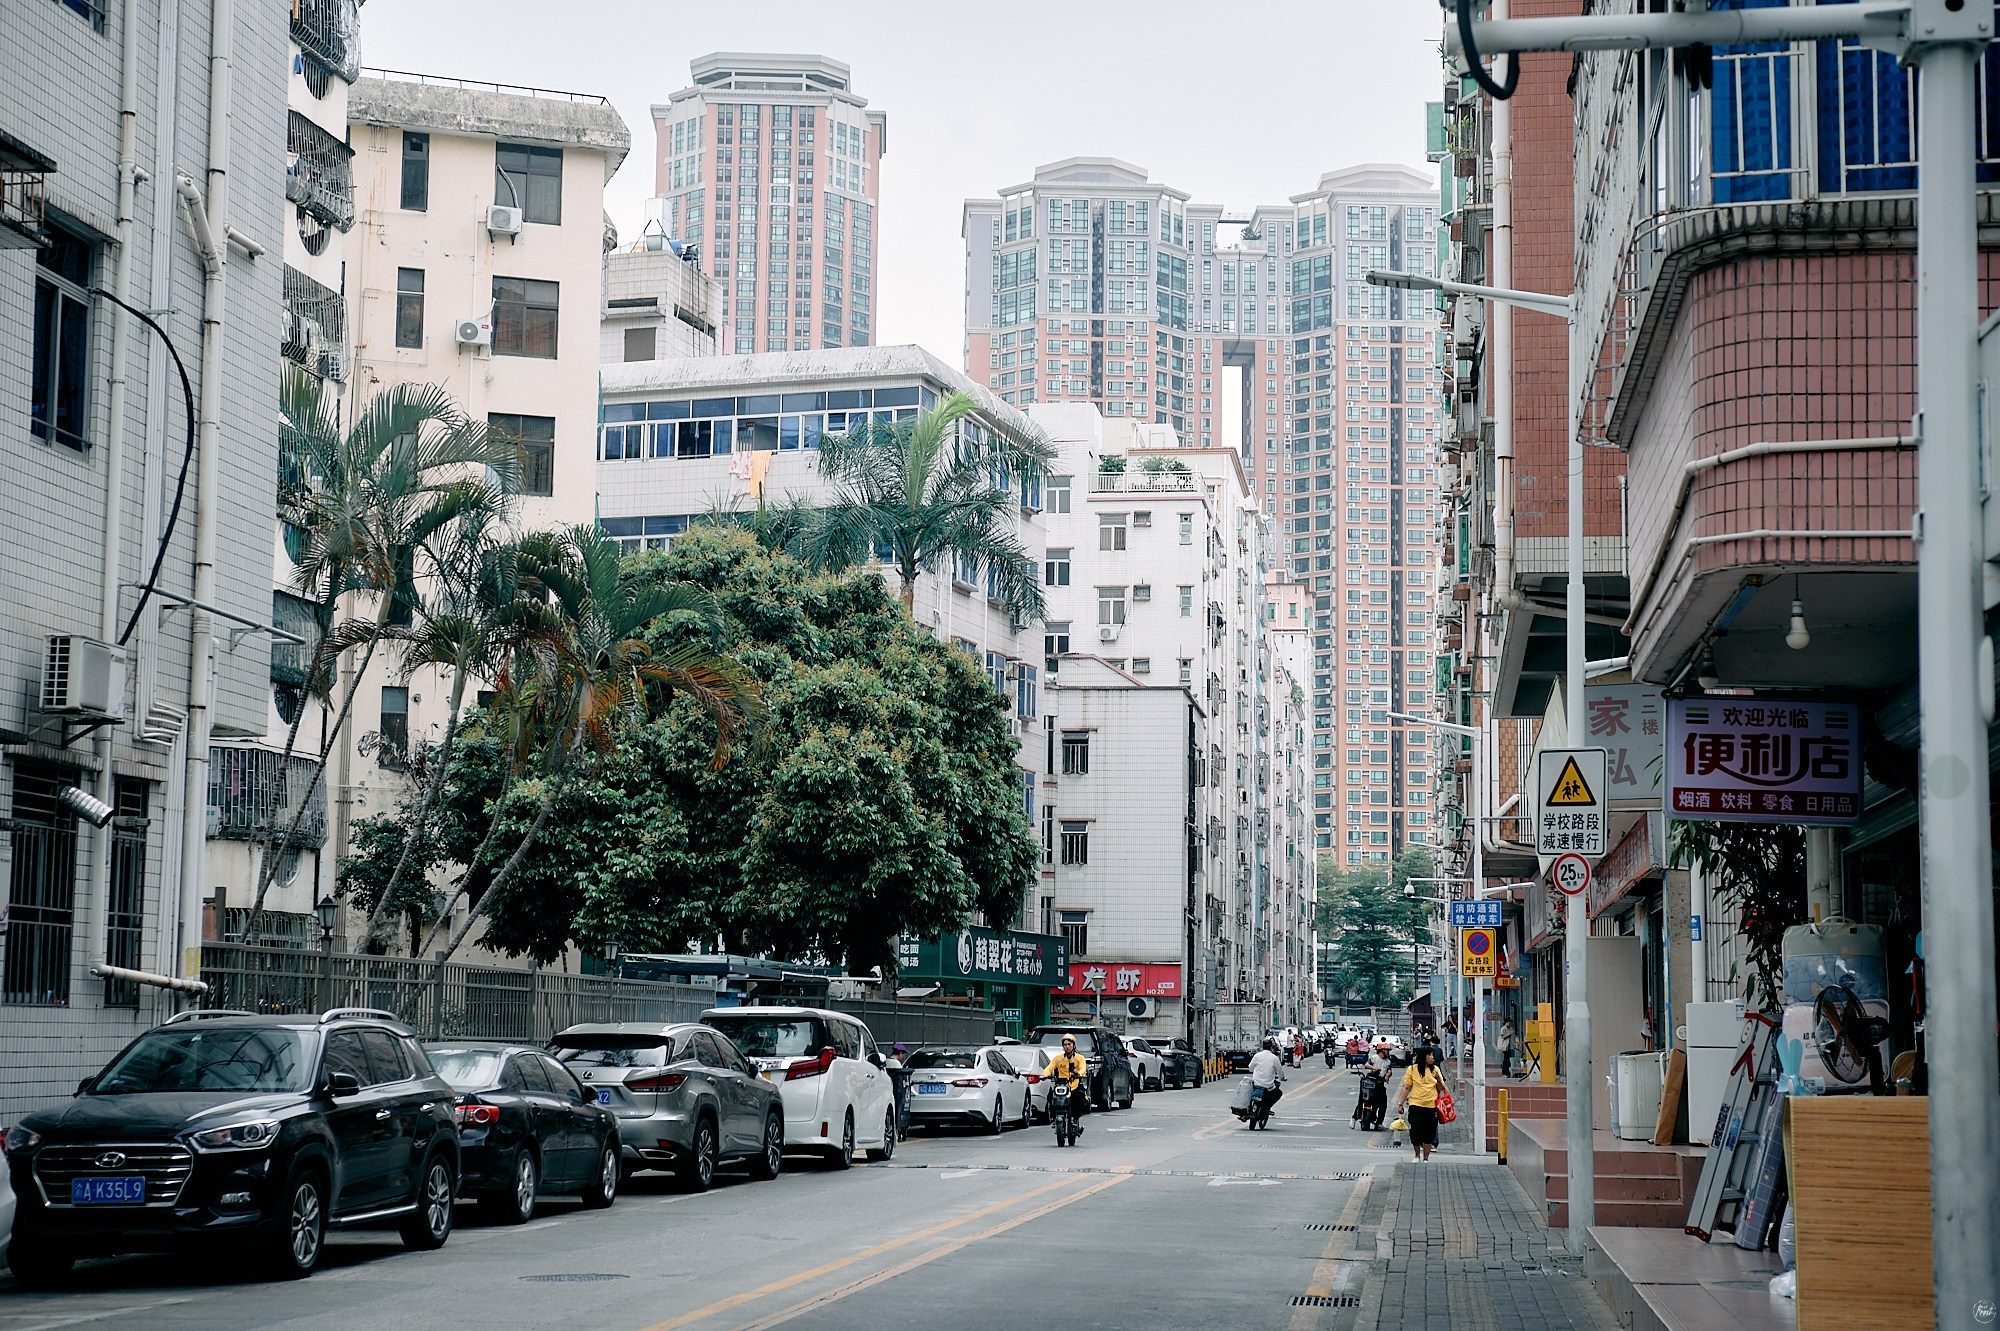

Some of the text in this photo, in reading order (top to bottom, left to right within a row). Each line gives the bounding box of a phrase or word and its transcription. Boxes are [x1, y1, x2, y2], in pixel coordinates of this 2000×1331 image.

[1722, 706, 1809, 729] 欢迎光临
[1683, 732, 1850, 787] 便利店
[1678, 791, 1852, 813] 烟酒 饮料 零食 日用品
[1543, 813, 1600, 831] 学校路段
[1542, 832, 1600, 850] 减速慢行
[1560, 863, 1577, 882] 25
[1455, 903, 1498, 914] 消防通道
[1455, 914, 1498, 924] 禁止停车
[900, 944, 920, 955] 吃面
[975, 936, 1013, 974] 趙翠花
[1015, 956, 1043, 976] 农家小炒
[1465, 966, 1493, 974] 严禁停车
[1467, 957, 1490, 965] 此路段
